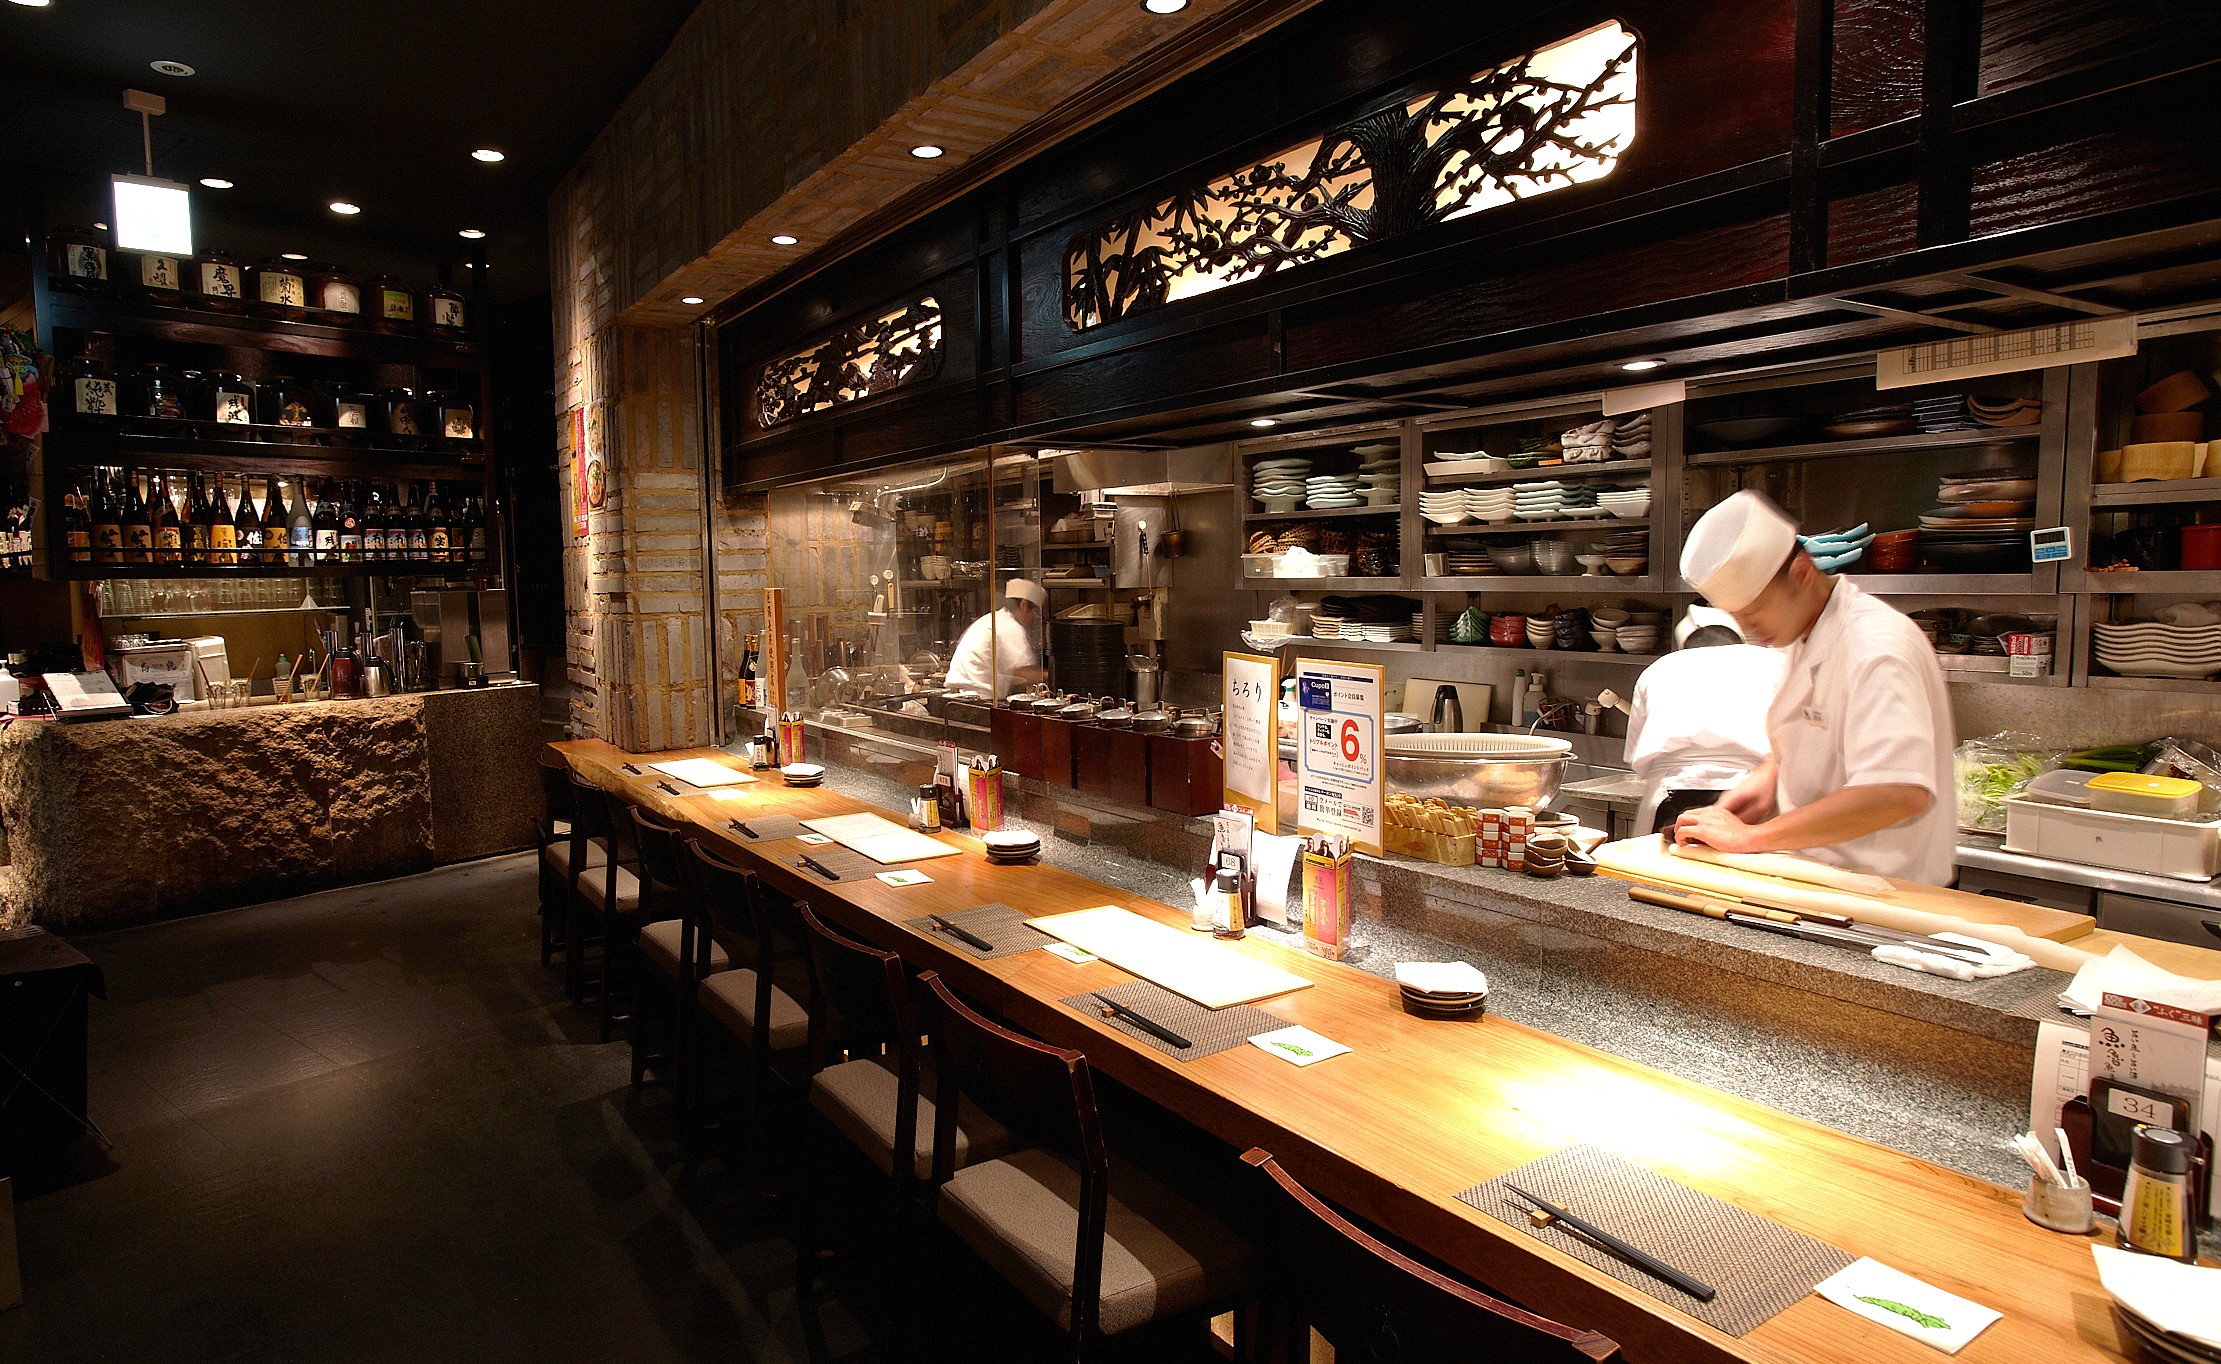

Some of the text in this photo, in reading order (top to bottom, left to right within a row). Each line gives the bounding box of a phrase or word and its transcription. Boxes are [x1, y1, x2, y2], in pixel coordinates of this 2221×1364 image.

[1232, 678, 1262, 702] ちろり
[1225, 857, 1236, 867] 68
[2123, 1097, 2157, 1120] 34
